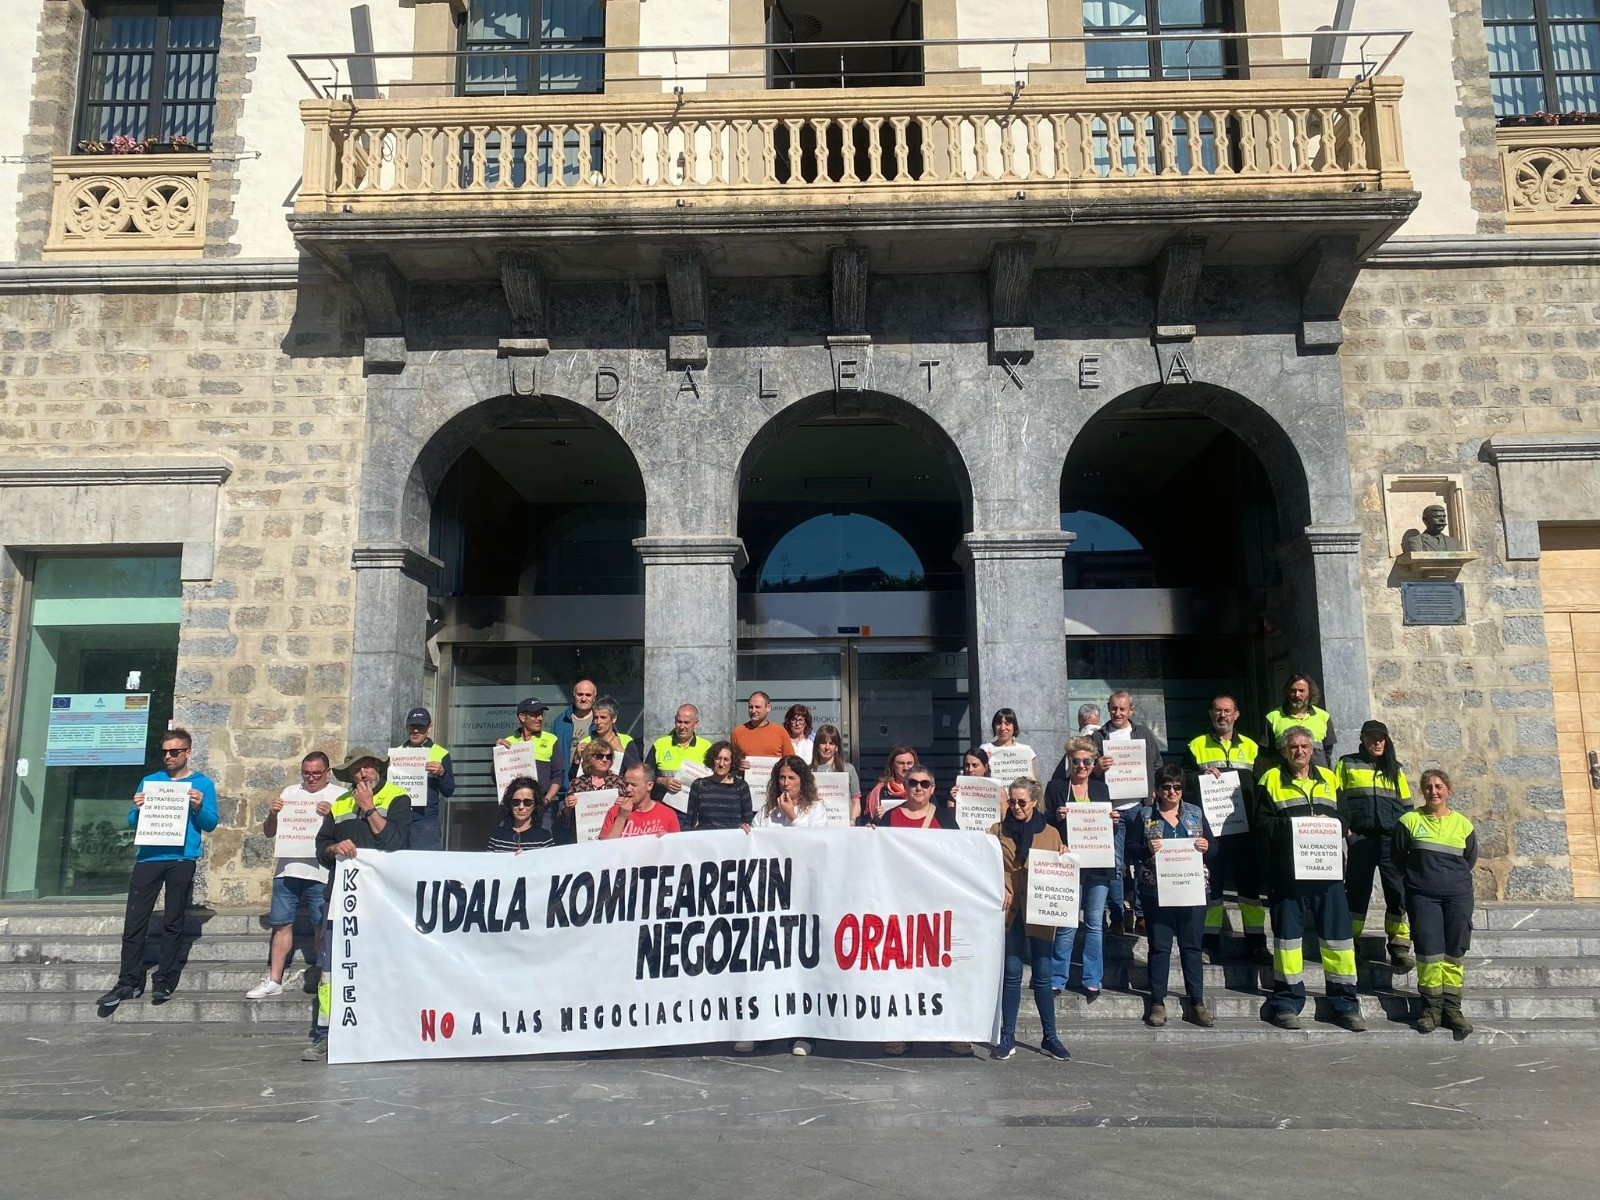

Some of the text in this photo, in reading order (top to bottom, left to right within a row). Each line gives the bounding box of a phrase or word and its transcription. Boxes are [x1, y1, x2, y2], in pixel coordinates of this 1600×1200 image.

[512, 350, 1193, 401] UDALETXEA
[621, 820, 664, 837] Athletic
[1033, 861, 1075, 870] LANPOSTUEN
[1034, 869, 1075, 877] BALORAZIOA
[415, 858, 792, 934] UDALA KOMITEAREKIN
[1034, 885, 1075, 894] VALORACIÓN
[1044, 893, 1074, 902] PUESTOS
[1038, 909, 1068, 917] TRABAJO
[342, 868, 359, 1027] KOMITEA
[636, 910, 953, 980] NEGOZIATU ORAIN!
[421, 991, 944, 1042] NO A LAS NEGOCIACIONES INDIVIDUALES
